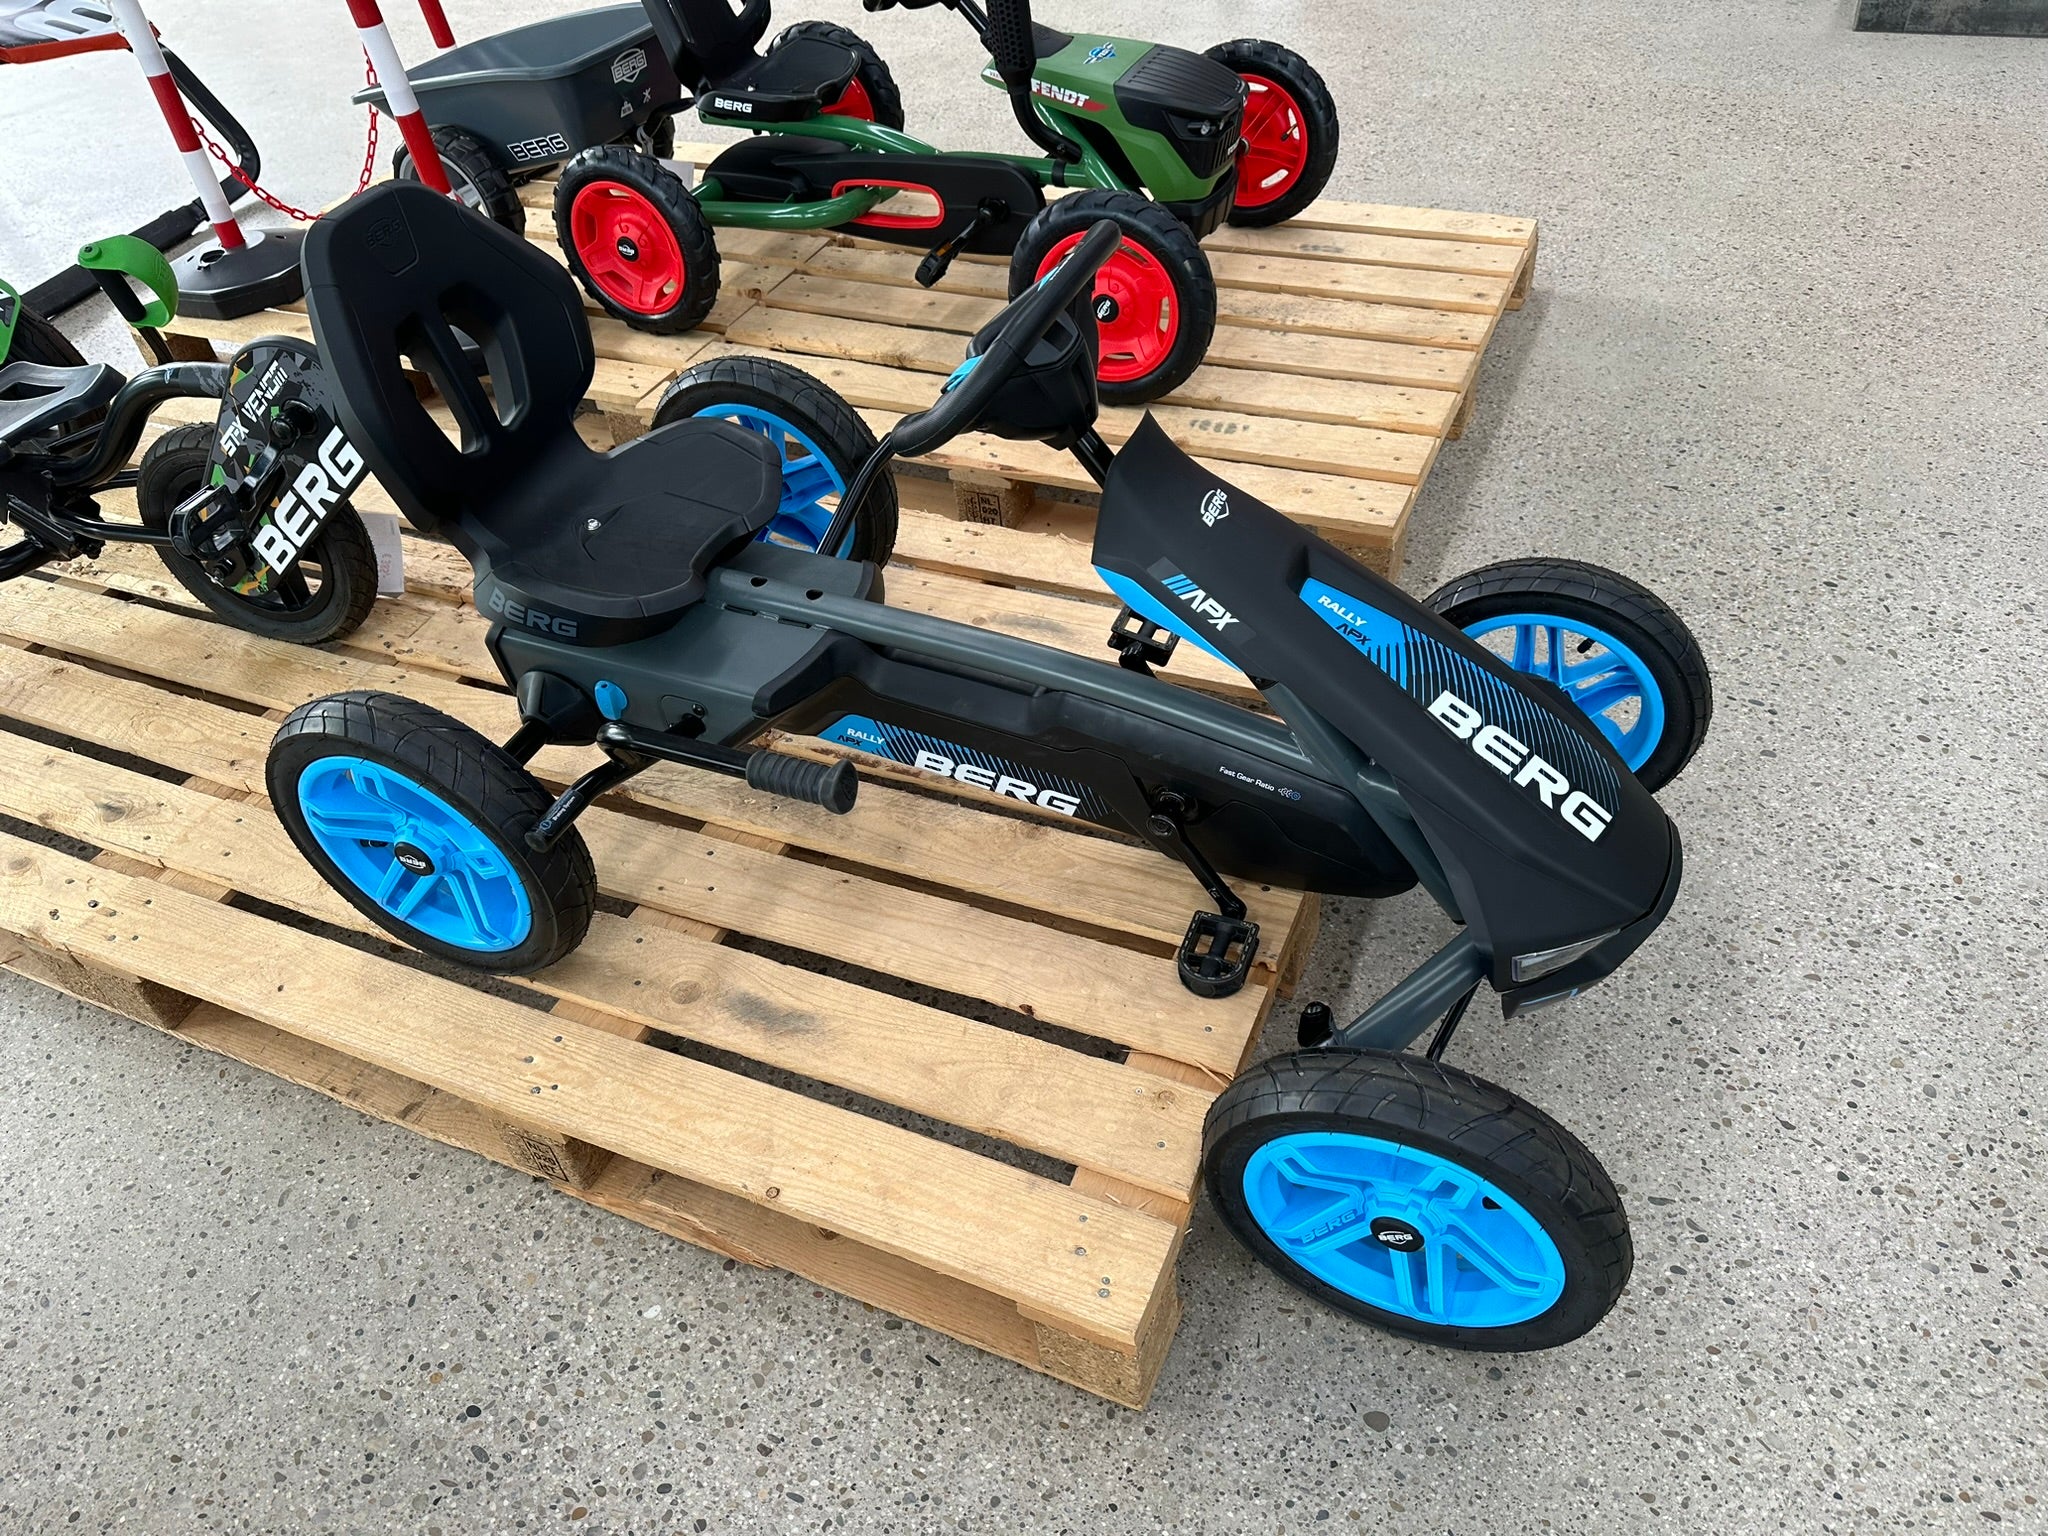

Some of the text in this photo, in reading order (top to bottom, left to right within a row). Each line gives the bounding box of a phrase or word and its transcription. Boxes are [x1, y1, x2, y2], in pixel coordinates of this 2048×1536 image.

[613, 53, 646, 80] BERG
[714, 97, 753, 114] BERG
[1031, 78, 1090, 108] FENDT
[507, 133, 570, 161] BERG
[252, 425, 364, 576] BERG
[1202, 488, 1228, 528] BERG
[488, 586, 578, 638] BERG
[1178, 588, 1240, 632] APX
[1317, 594, 1368, 627] RALLY
[1336, 623, 1372, 646] APX
[847, 727, 885, 744] RALLY
[1219, 766, 1275, 791] Fast Gear Ratio
[1427, 690, 1623, 842] BERG
[914, 749, 1081, 817] BERG
[1302, 1209, 1358, 1244] BERG
[1378, 1233, 1413, 1242] BERG
